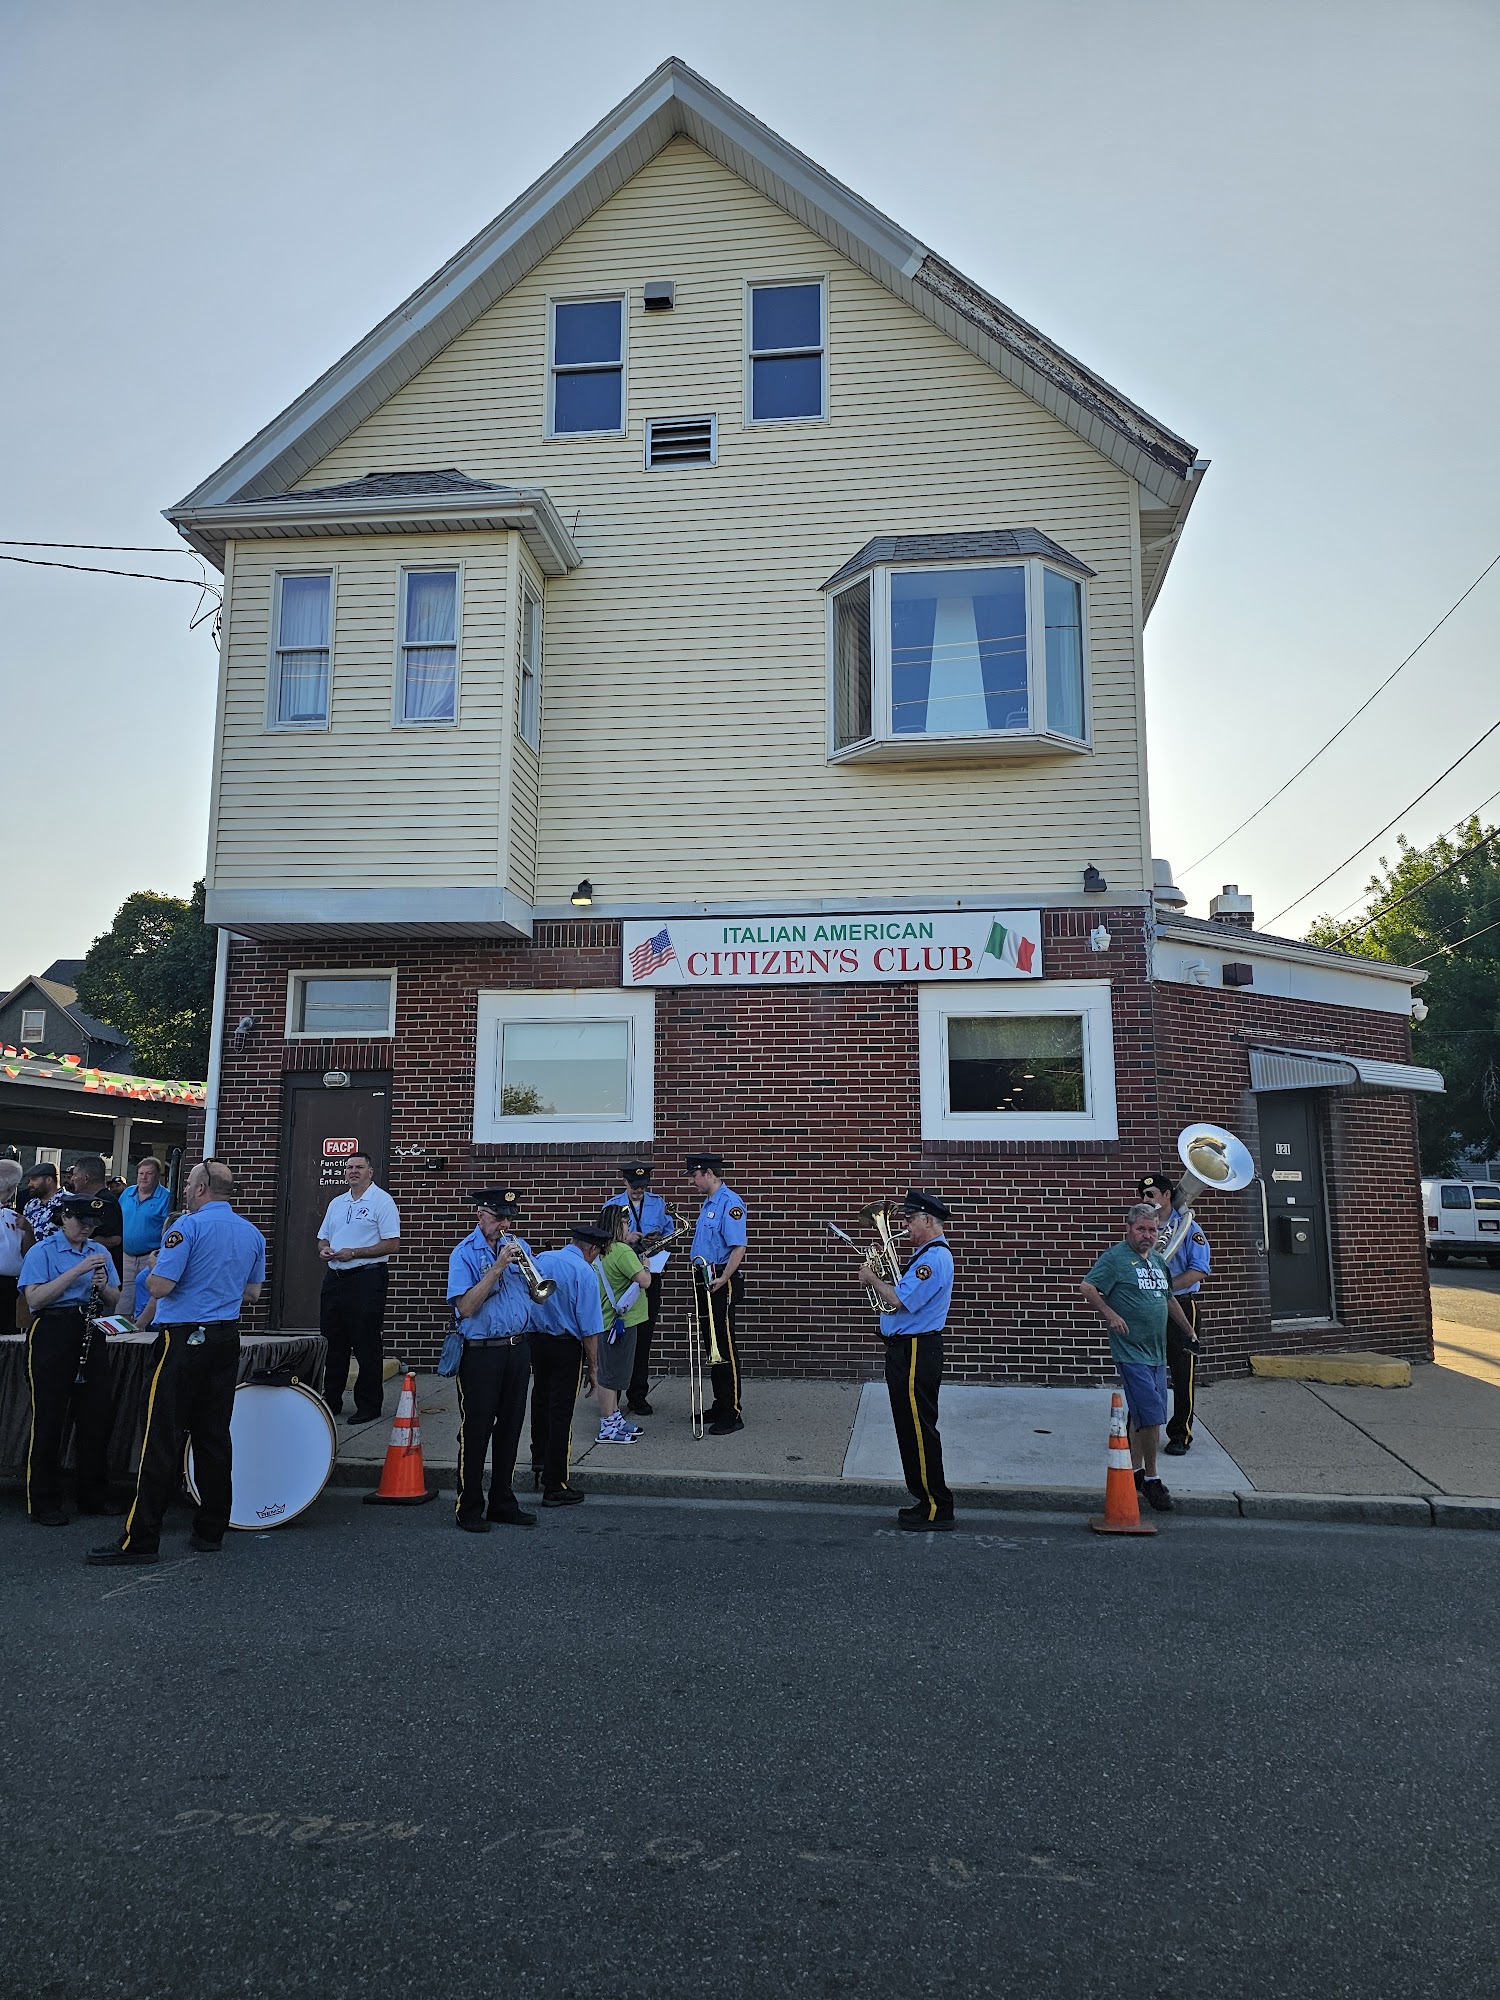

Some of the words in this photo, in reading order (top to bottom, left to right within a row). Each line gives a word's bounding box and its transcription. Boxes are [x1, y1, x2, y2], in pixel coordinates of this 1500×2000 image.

[723, 925, 806, 944] ITALIAN
[813, 922, 934, 942] AMERICAN
[687, 947, 859, 976] CITIZEN'S
[873, 945, 973, 972] CLUB
[326, 1141, 355, 1153] FACP
[1277, 1144, 1290, 1154] 121
[320, 1159, 347, 1167] Functi
[322, 1168, 346, 1176] Hal
[319, 1177, 349, 1186] Entranc
[1136, 1267, 1165, 1279] BOTON
[1138, 1278, 1156, 1290] RED
[1156, 1278, 1169, 1290] SO
